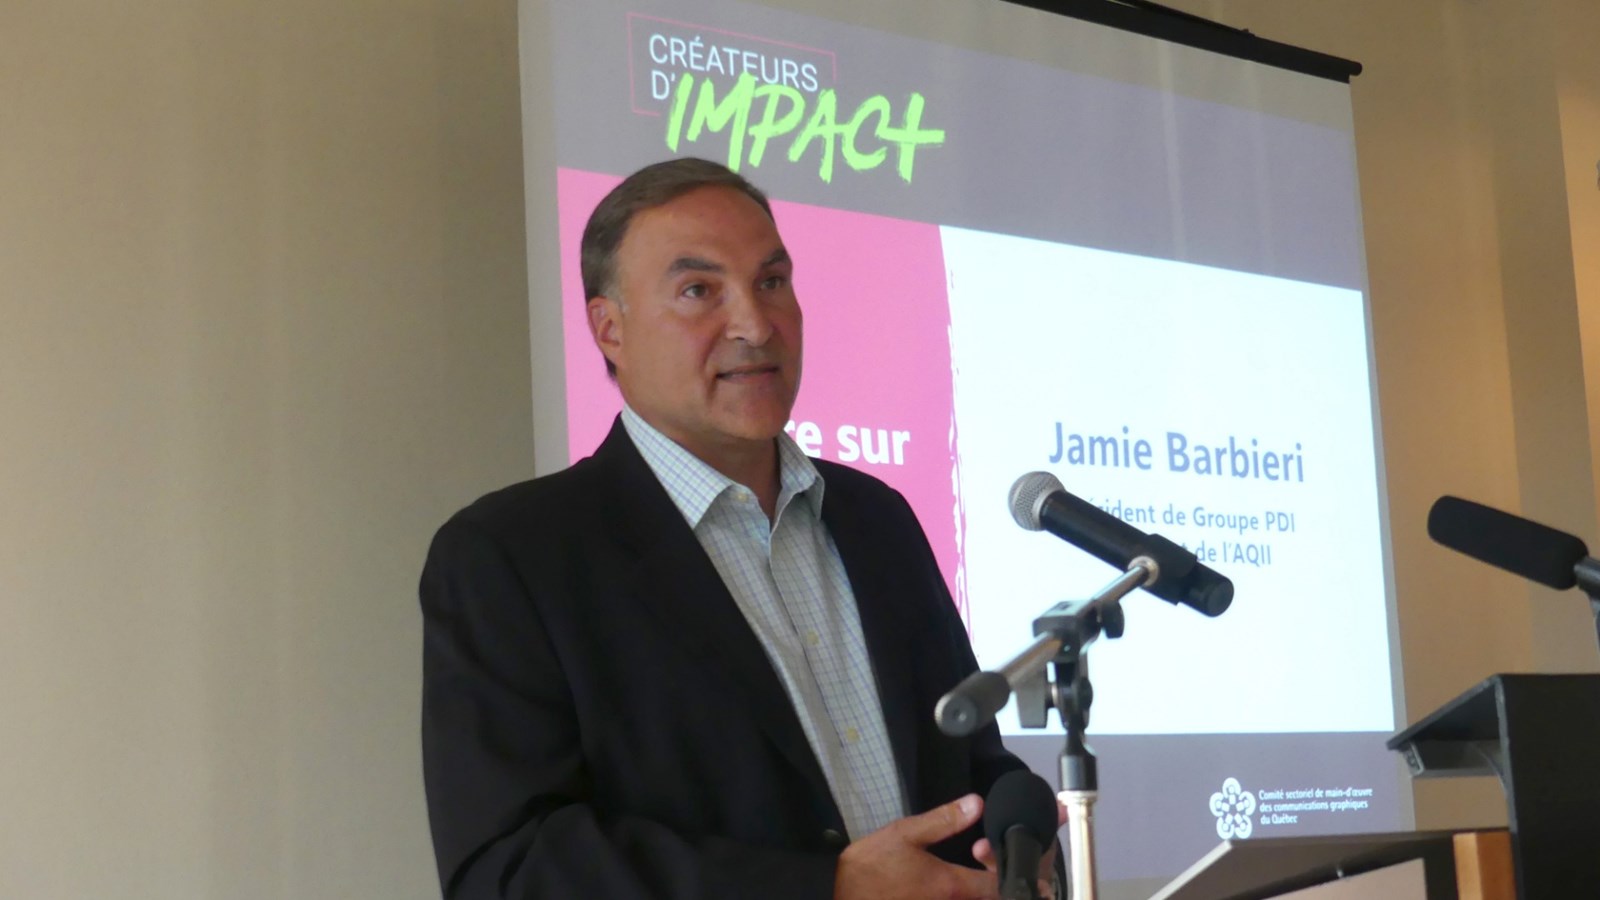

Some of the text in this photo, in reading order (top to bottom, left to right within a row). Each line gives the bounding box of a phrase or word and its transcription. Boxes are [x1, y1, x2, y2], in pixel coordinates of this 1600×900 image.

[649, 34, 818, 92] CRÉATEURS
[837, 424, 911, 466] sur
[1049, 421, 1304, 482] Jamie Barbieri
[1162, 503, 1186, 526] de
[1193, 506, 1259, 535] Groupe
[1265, 511, 1296, 533] PDI
[1196, 540, 1218, 562] de
[1259, 789, 1284, 800] Comité
[1285, 788, 1314, 800] sectoriel
[1315, 787, 1325, 799] de
[1260, 800, 1368, 812] des communications graphiques
[1261, 813, 1298, 825] du Québec
